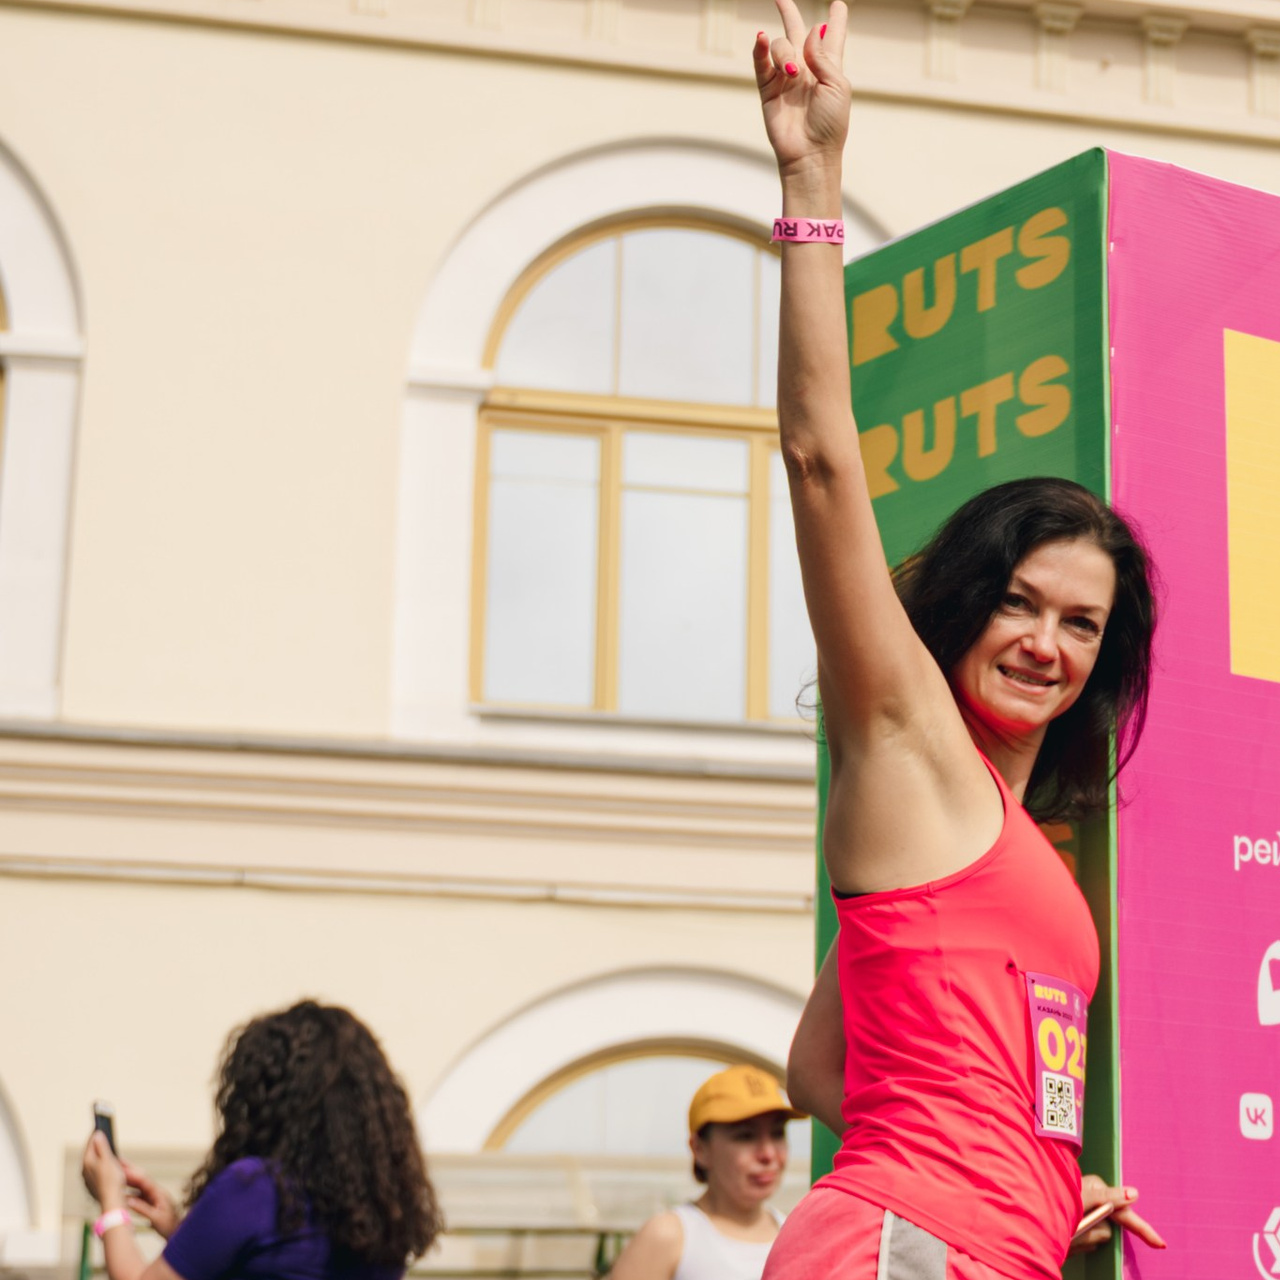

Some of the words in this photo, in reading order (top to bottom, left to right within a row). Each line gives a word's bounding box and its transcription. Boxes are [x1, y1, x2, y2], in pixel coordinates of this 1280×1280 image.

[852, 206, 1071, 367] RUTS
[859, 355, 1071, 500] RUTS
[1034, 984, 1067, 1005] RUTS
